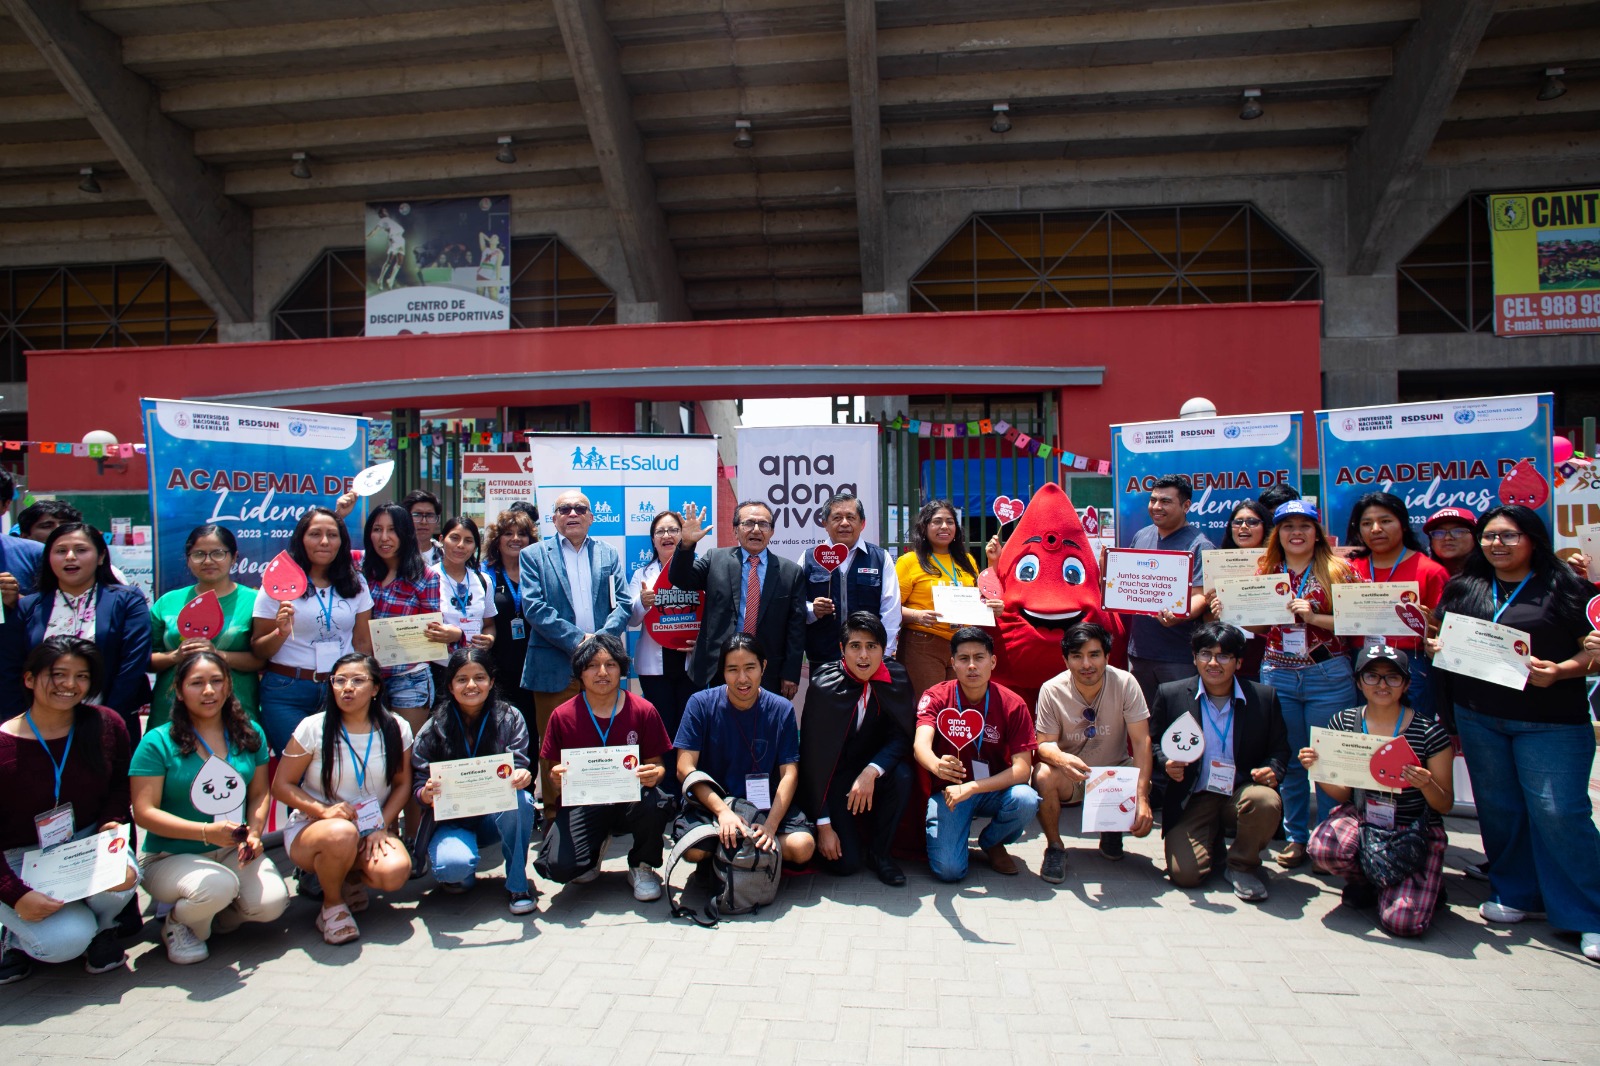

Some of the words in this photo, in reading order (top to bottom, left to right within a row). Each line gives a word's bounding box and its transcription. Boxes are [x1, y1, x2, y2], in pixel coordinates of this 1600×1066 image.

[407, 300, 448, 311] CENTRO
[451, 299, 466, 310] DE
[1503, 297, 1538, 318] CEL:
[1541, 295, 1577, 316] 988
[370, 313, 435, 324] DISCIPLINAS
[438, 310, 504, 322] DEPORTIVAS
[1504, 319, 1543, 332] E-mail:
[192, 413, 230, 421] UNIVERSIDAD
[1401, 414, 1444, 423] RSDSUNI
[238, 419, 280, 428] RSDSUNI
[1180, 429, 1216, 437] RSDSUNI
[610, 454, 679, 471] EsSalud
[758, 454, 834, 476] ama
[1335, 460, 1490, 485] ACADEMIA
[167, 467, 318, 495] ACADEMIA
[1126, 470, 1253, 493] ACDEMIA
[1258, 470, 1290, 488] DE
[592, 514, 620, 523] sSalud
[238, 530, 262, 538] 2023
[270, 530, 294, 538] 2024
[1142, 574, 1178, 582] salvamos
[1140, 588, 1166, 597] Sangre
[654, 594, 700, 606] SANGRE
[1126, 595, 1163, 604] Plaquetas
